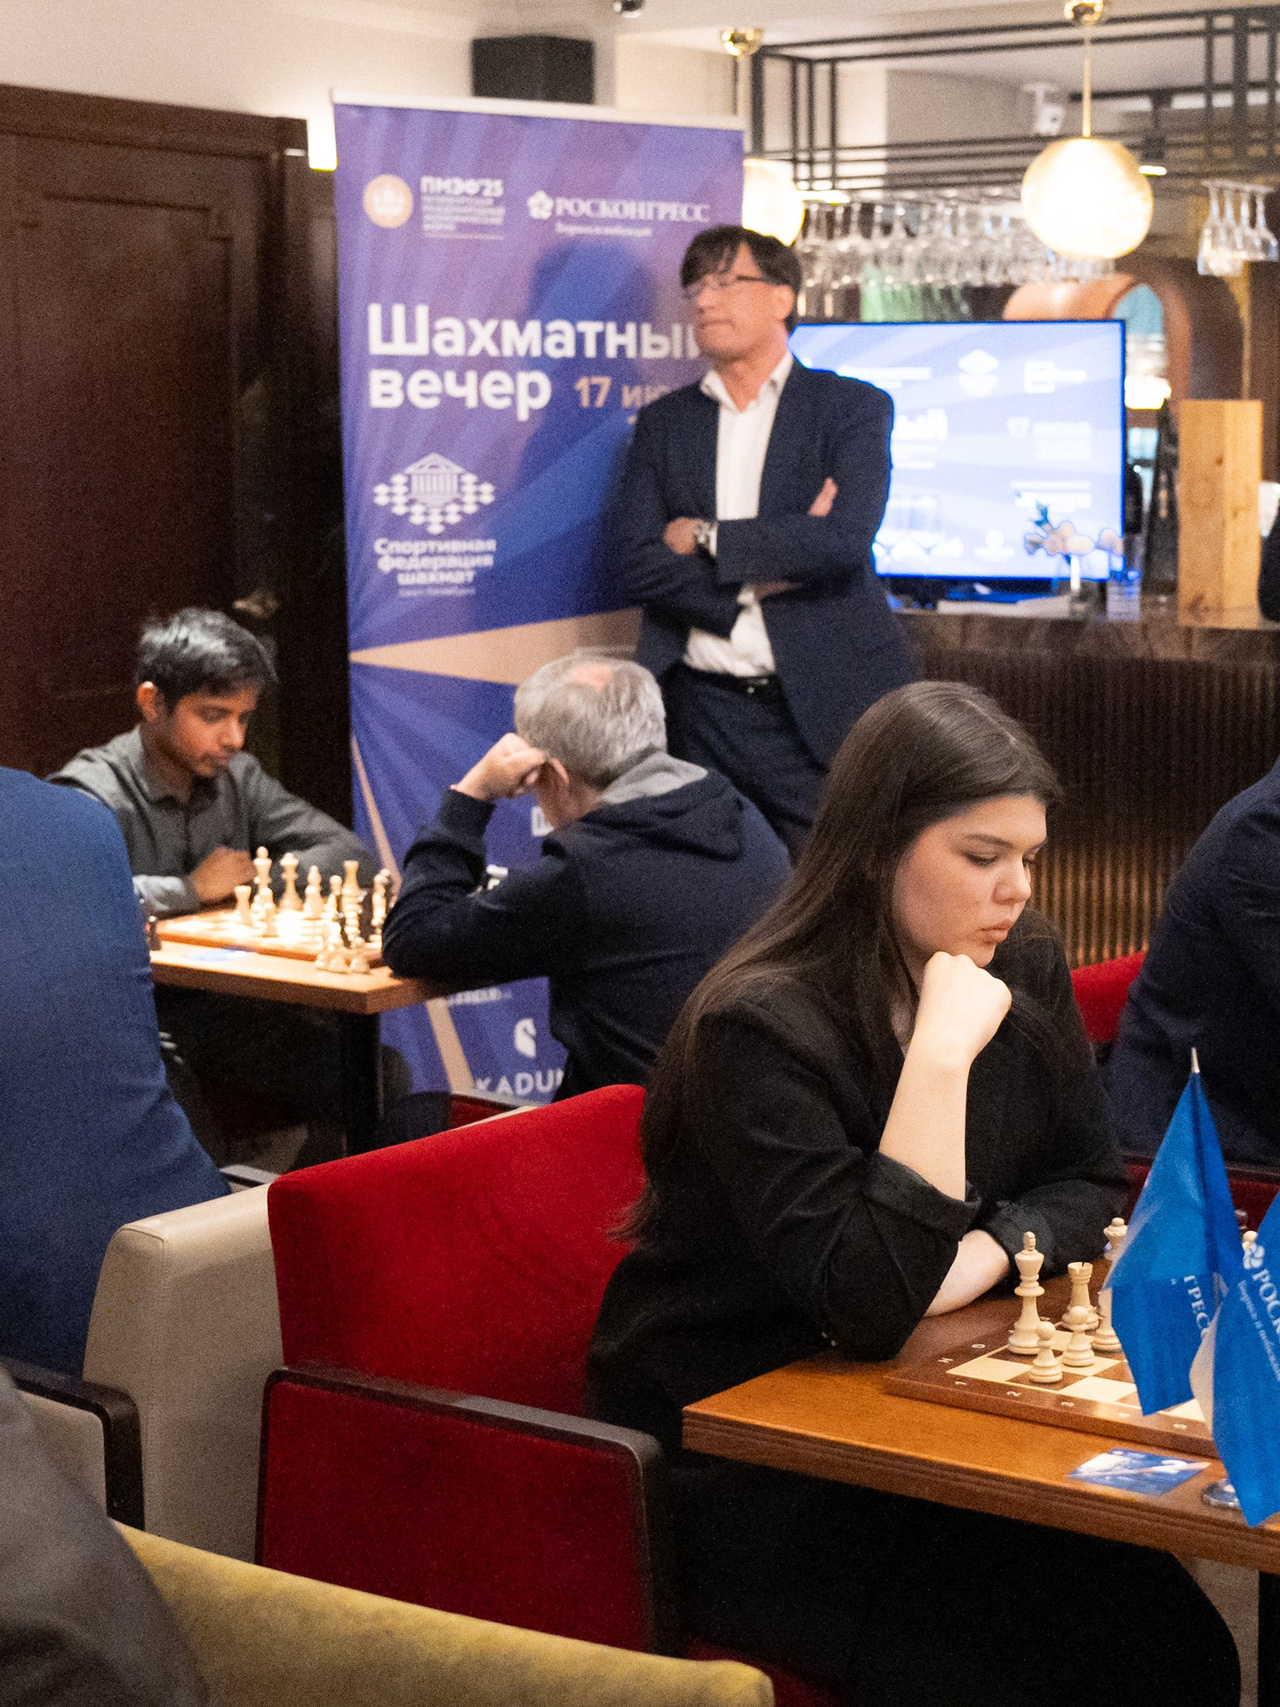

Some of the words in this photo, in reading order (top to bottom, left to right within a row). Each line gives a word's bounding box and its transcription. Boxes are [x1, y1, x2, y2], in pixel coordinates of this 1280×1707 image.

[555, 197, 710, 223] РОСКОНГРЕСС
[368, 368, 552, 422] вечер
[575, 376, 612, 409] 17
